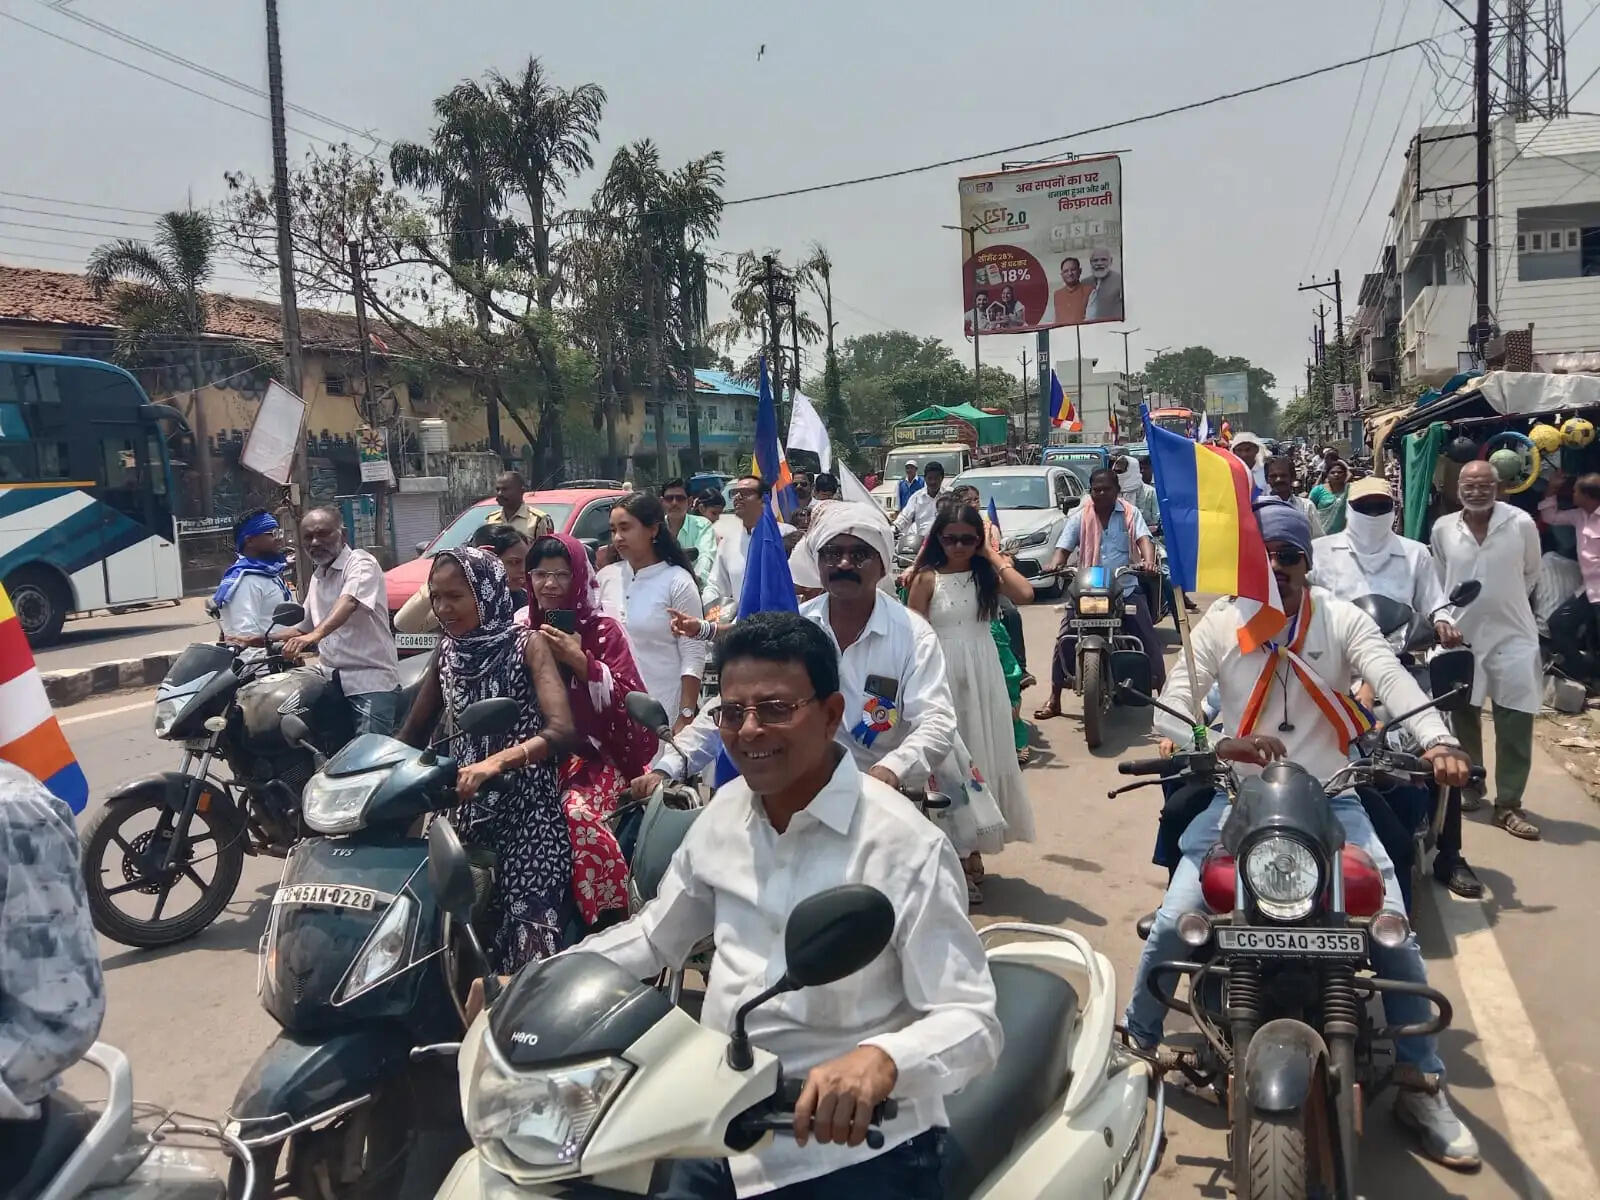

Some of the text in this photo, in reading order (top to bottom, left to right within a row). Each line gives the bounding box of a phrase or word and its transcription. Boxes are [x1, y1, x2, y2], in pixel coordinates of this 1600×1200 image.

[1016, 172, 1100, 193] अब सपनों का घर
[1006, 210, 1027, 226] 2.0
[1002, 268, 1031, 283] 18%
[332, 848, 355, 857] TVS
